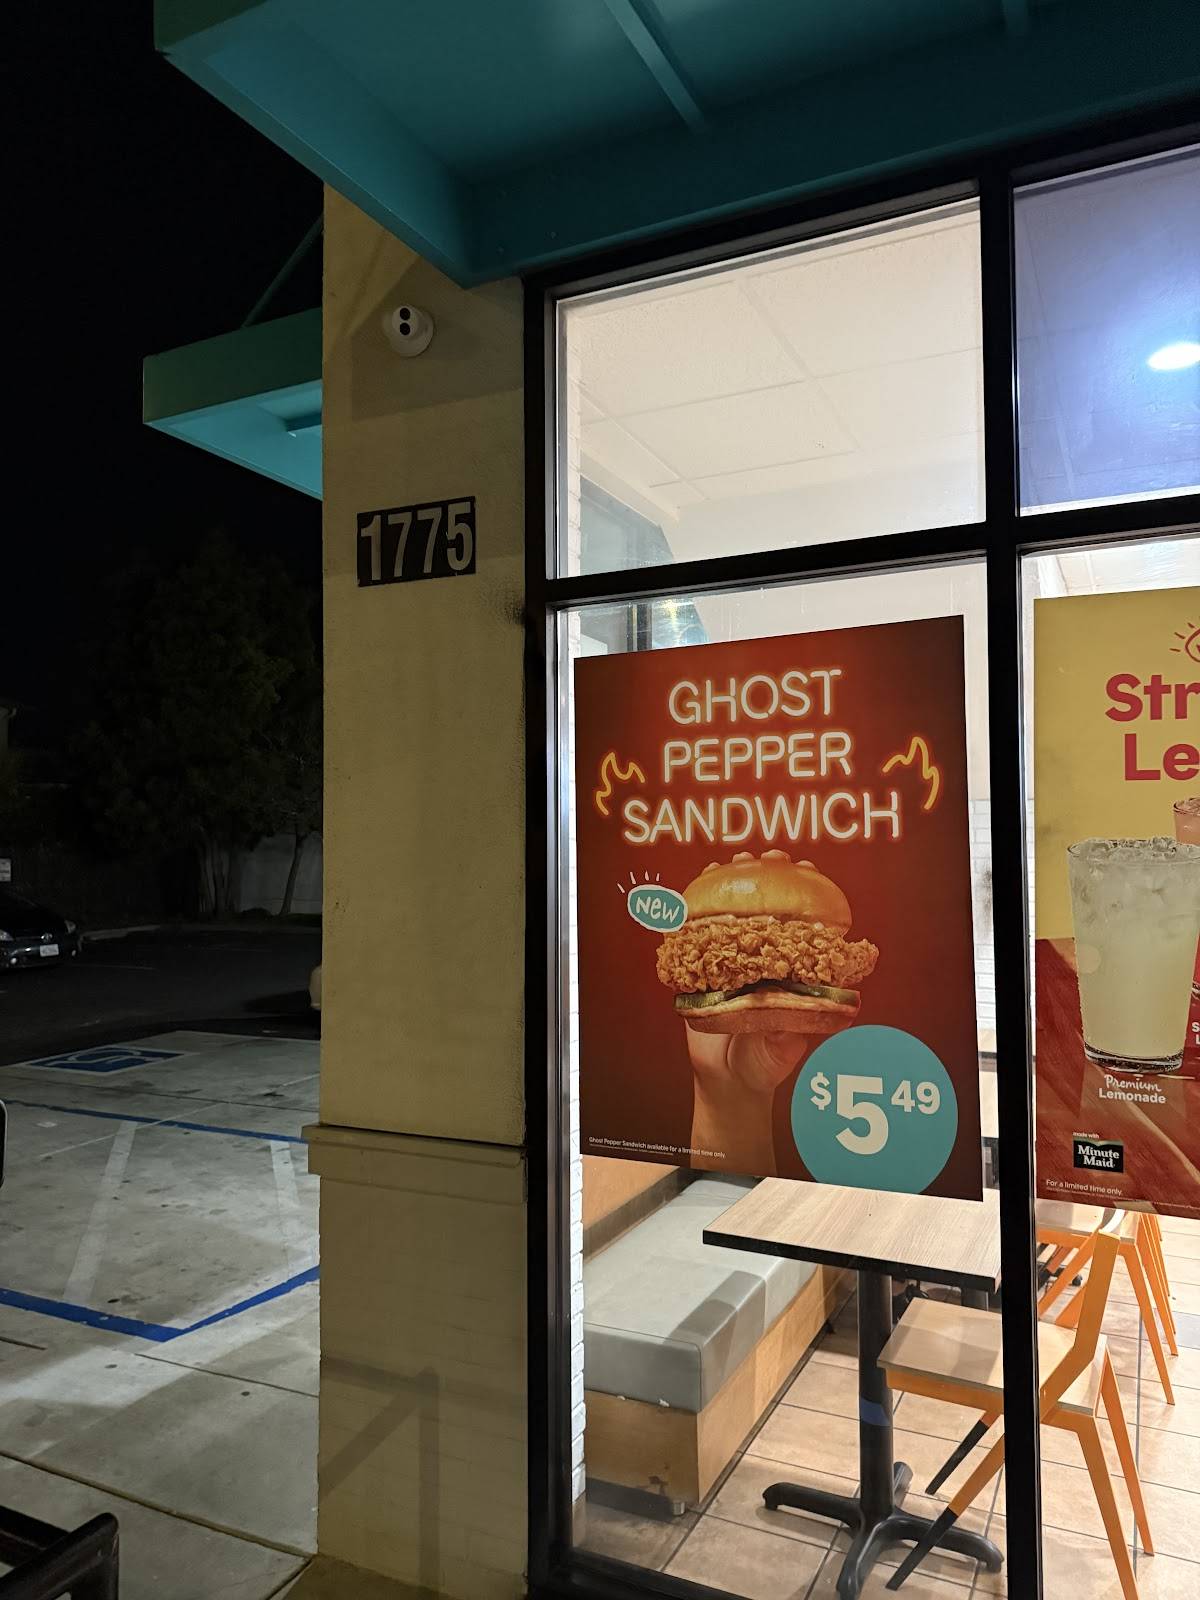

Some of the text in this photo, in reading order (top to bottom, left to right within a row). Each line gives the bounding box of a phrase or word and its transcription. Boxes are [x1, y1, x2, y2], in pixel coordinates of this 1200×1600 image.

[361, 501, 473, 580] 1775
[668, 669, 842, 724] GHOST
[1105, 673, 1200, 722] Str
[663, 731, 852, 783] PEPPER
[1124, 733, 1200, 781] Le
[623, 791, 900, 843] SANDWICH
[1098, 1087, 1167, 1104] Lemonade
[1104, 1074, 1162, 1092] Premium
[589, 1136, 604, 1144] Ghost
[604, 1138, 622, 1147] Pepper
[622, 1140, 647, 1149] Sandwich
[647, 1143, 669, 1152] available
[682, 1147, 701, 1155] limited
[701, 1149, 713, 1157] time
[1077, 1144, 1120, 1159] Minute
[1083, 1154, 1114, 1168] Maid
[1046, 1179, 1058, 1187] For
[1064, 1181, 1089, 1191] limited
[1089, 1184, 1105, 1194] time
